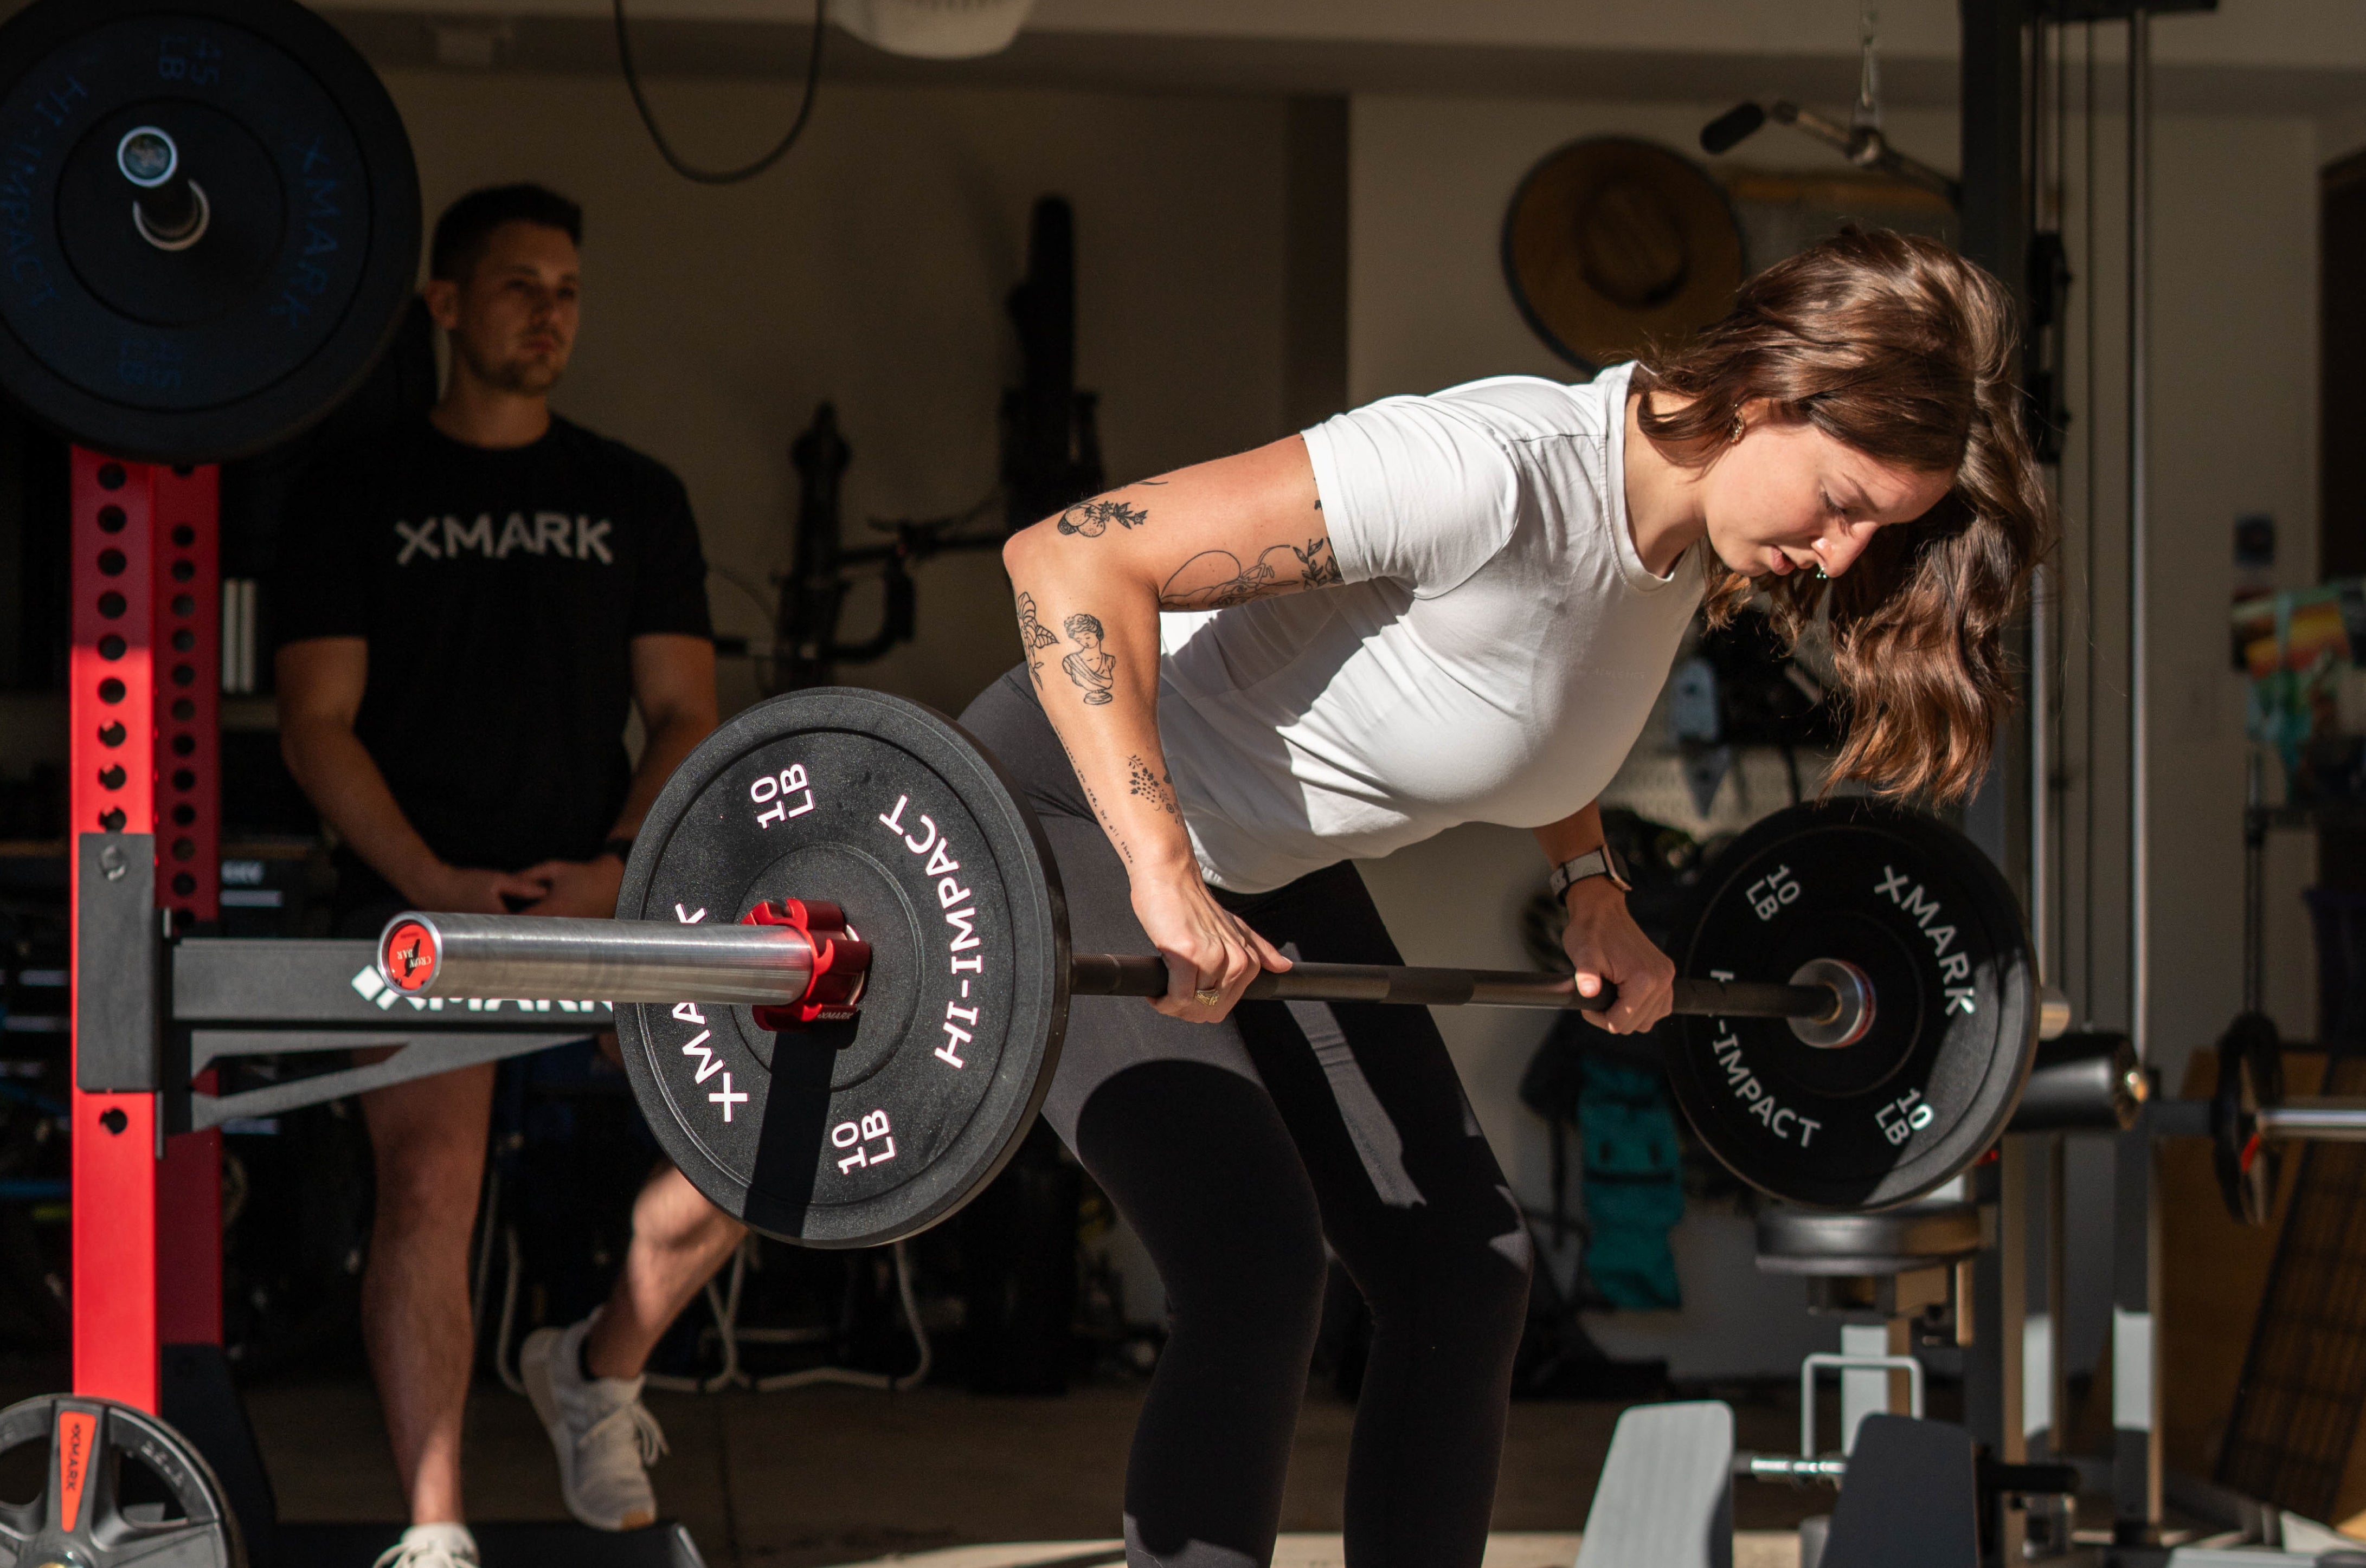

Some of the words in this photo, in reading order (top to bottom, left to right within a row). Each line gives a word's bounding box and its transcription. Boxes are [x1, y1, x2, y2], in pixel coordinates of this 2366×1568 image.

[268, 133, 341, 330] XMARK
[393, 510, 614, 567] XMARK
[750, 775, 786, 830] 10
[779, 763, 815, 820] LB
[1745, 879, 1780, 922] LB
[1765, 864, 1802, 906] 10
[879, 794, 983, 1069] HI-IMPACT
[1873, 864, 1977, 1017] XMARK
[818, 1011, 853, 1019] XMARK
[1874, 1102, 1913, 1146] LB
[1896, 1087, 1935, 1132] 10
[831, 1121, 867, 1175] 10
[860, 1108, 897, 1167] LB
